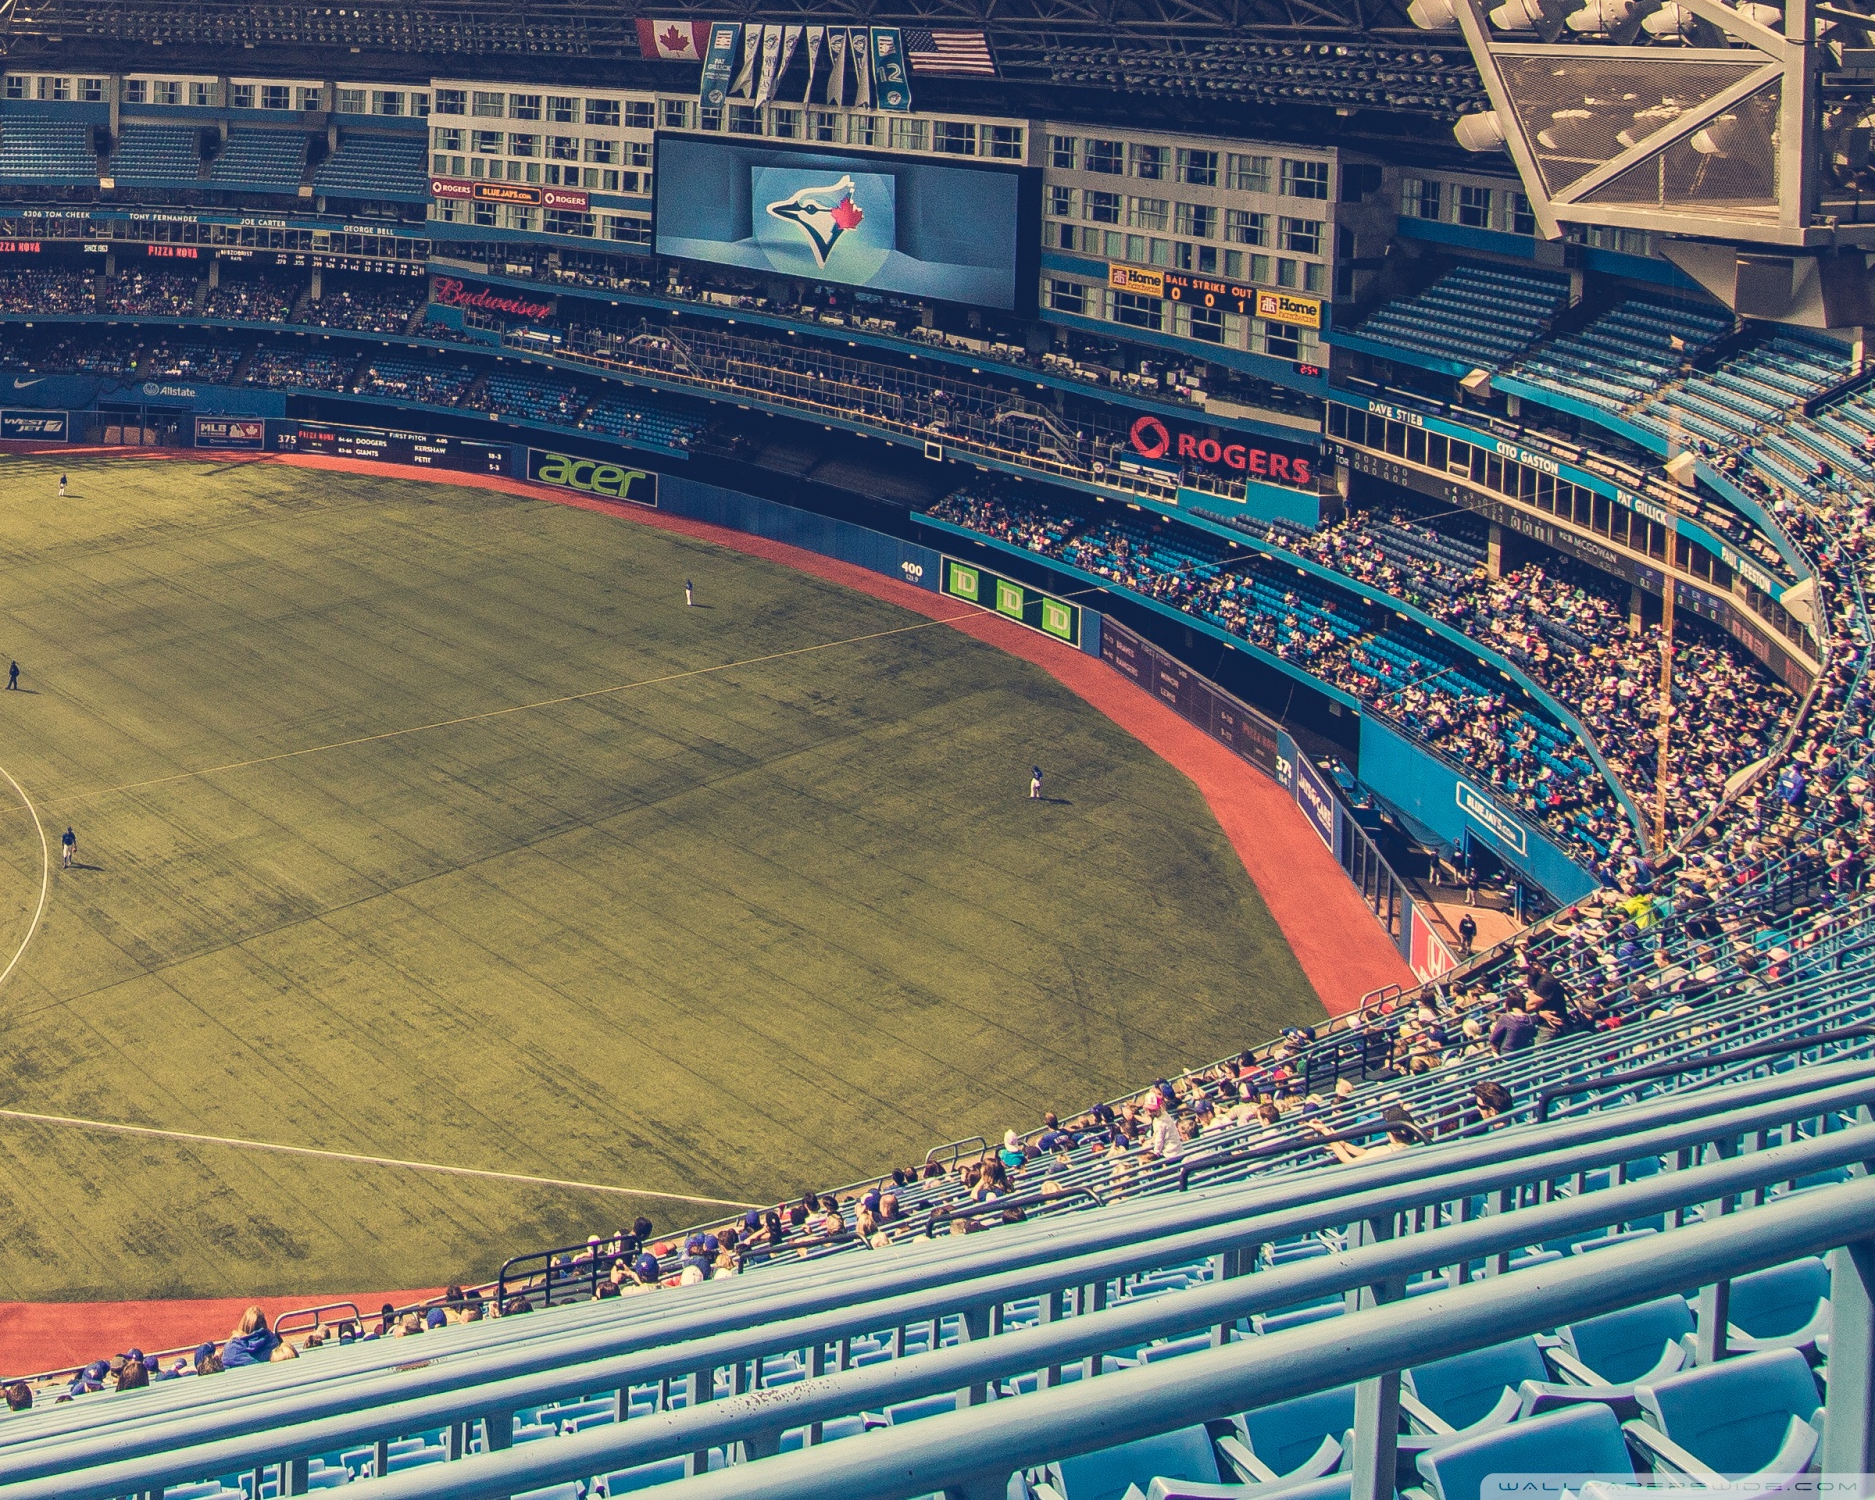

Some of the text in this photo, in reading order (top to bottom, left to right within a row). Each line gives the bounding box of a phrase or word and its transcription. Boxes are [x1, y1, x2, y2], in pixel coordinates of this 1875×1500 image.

[877, 64, 903, 83] 12
[442, 184, 471, 194] ROGERS
[555, 195, 586, 206] ROGERS
[23, 211, 42, 219] 4306
[65, 211, 91, 219] CHEEK
[129, 213, 198, 223] TONY FERNANDEZ
[240, 218, 287, 227] JOE CARTER
[343, 225, 395, 236] GEORGE BELL
[19, 241, 41, 253] NOVA
[148, 245, 198, 259] PIZZA NOVA
[1128, 270, 1161, 287] Home
[1127, 281, 1161, 295] hardware
[1165, 274, 1253, 299] BALL STRIKE OUT
[434, 277, 551, 318] Budweiser
[1171, 287, 1244, 314] 0 0 1
[1278, 298, 1317, 316] Home
[1278, 311, 1317, 324] hardware
[1300, 364, 1319, 376] 2:54
[159, 384, 196, 398] Allstate
[1368, 401, 1423, 427] DAVE STIEB
[4, 418, 46, 427] WEST
[15, 425, 44, 433] JET
[200, 423, 227, 432] MLB
[277, 434, 297, 444] 375
[389, 432, 407, 440] FIRST
[408, 433, 427, 442] PITCH
[355, 438, 388, 447] DODGERS
[414, 445, 446, 454] KERSHAW
[1335, 445, 1344, 455] TB
[355, 448, 379, 457] GIANTS
[414, 456, 432, 464] PETIT
[1178, 433, 1311, 484] ROGERS
[1335, 455, 1350, 466] TOR
[1496, 441, 1559, 475] CITO GASTON
[538, 453, 646, 498] acer
[1616, 489, 1669, 526] PAT GILLICK
[1574, 537, 1617, 564] MCGOWAN
[901, 560, 923, 578] 400
[1722, 546, 1771, 594] PAUL BEESTON
[953, 568, 976, 594] TD
[999, 586, 1022, 612] TD
[1045, 604, 1069, 631] TD
